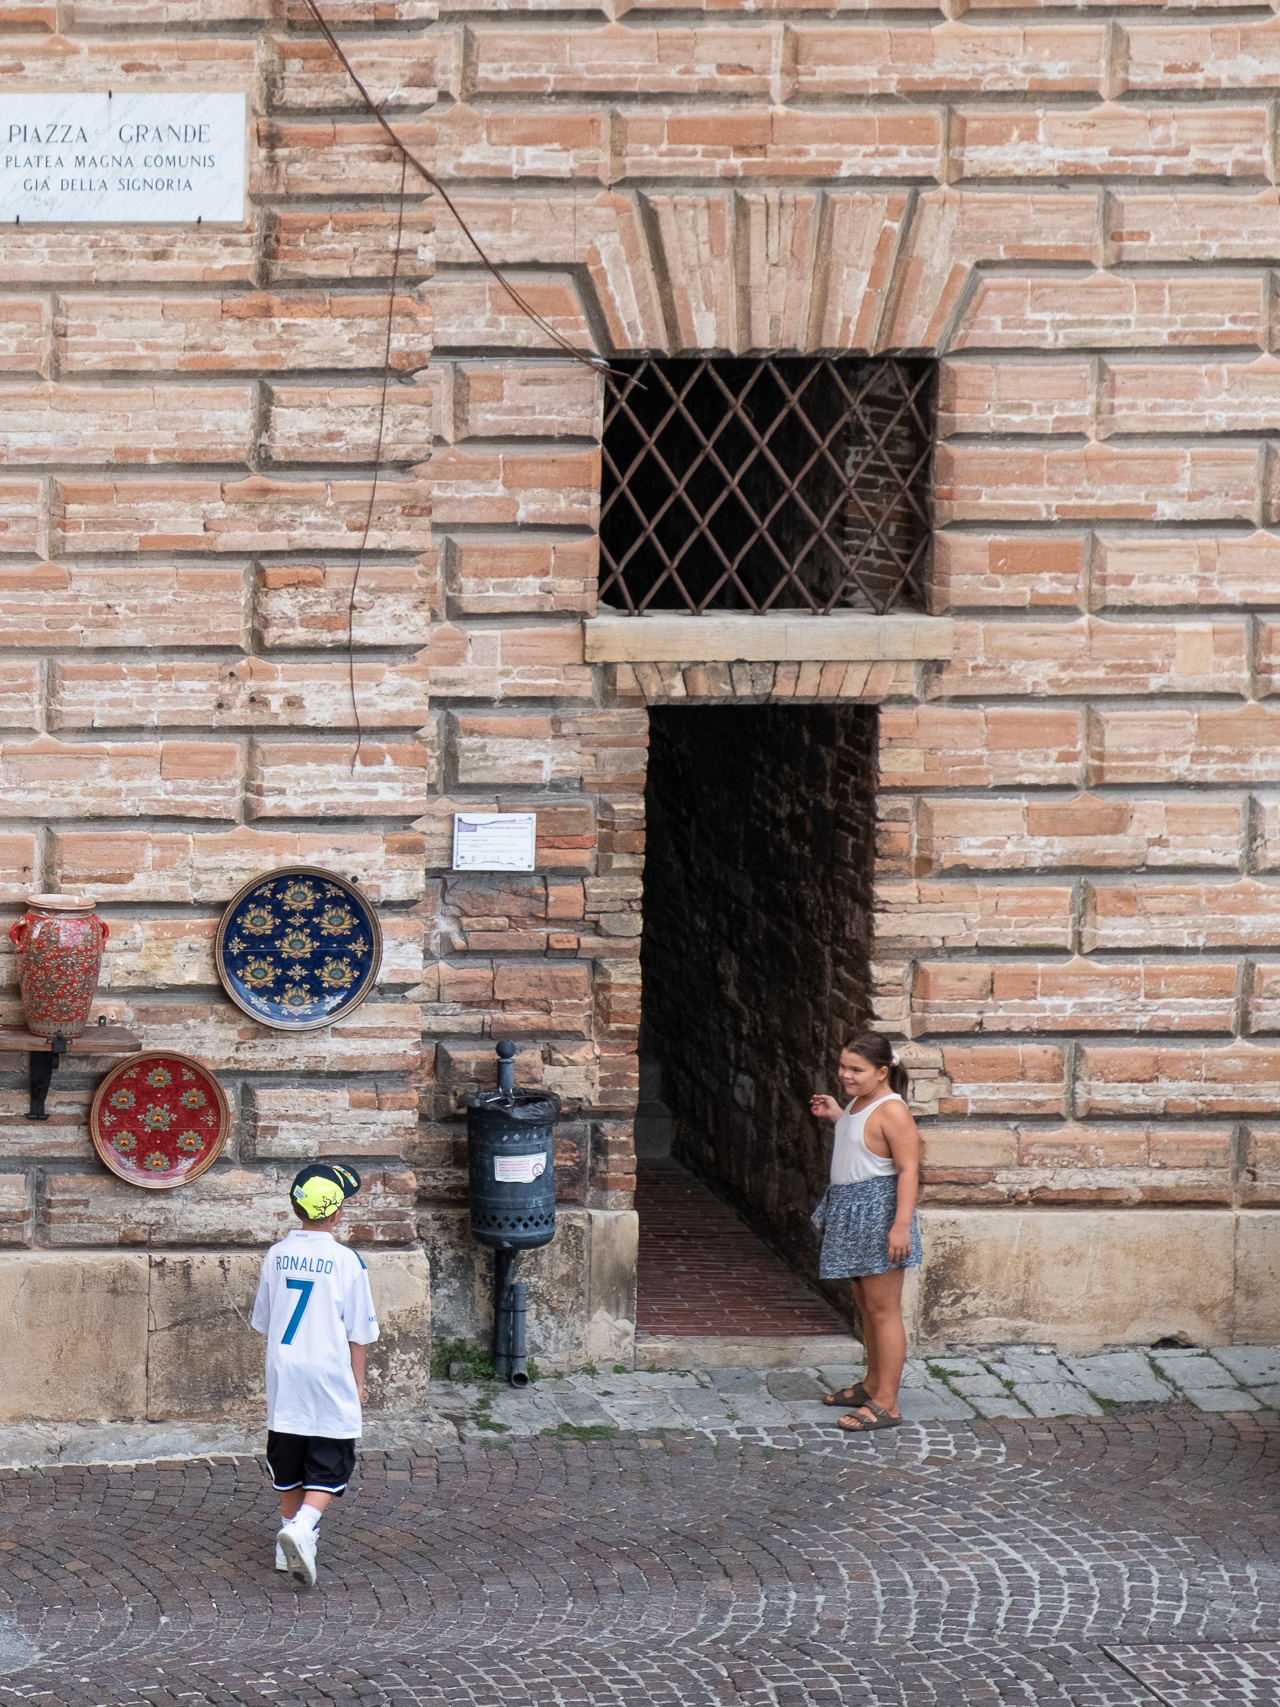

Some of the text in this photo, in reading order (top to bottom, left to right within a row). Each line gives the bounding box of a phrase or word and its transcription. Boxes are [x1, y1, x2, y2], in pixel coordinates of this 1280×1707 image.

[9, 124, 210, 143] PIAZZA GRANDE
[5, 155, 216, 168] PLATEA MAGNA COMUNIS
[23, 175, 193, 191] GIÀ DELLA SIGNORIA
[276, 1255, 334, 1275] RONALDO
[280, 1277, 315, 1346] 7
